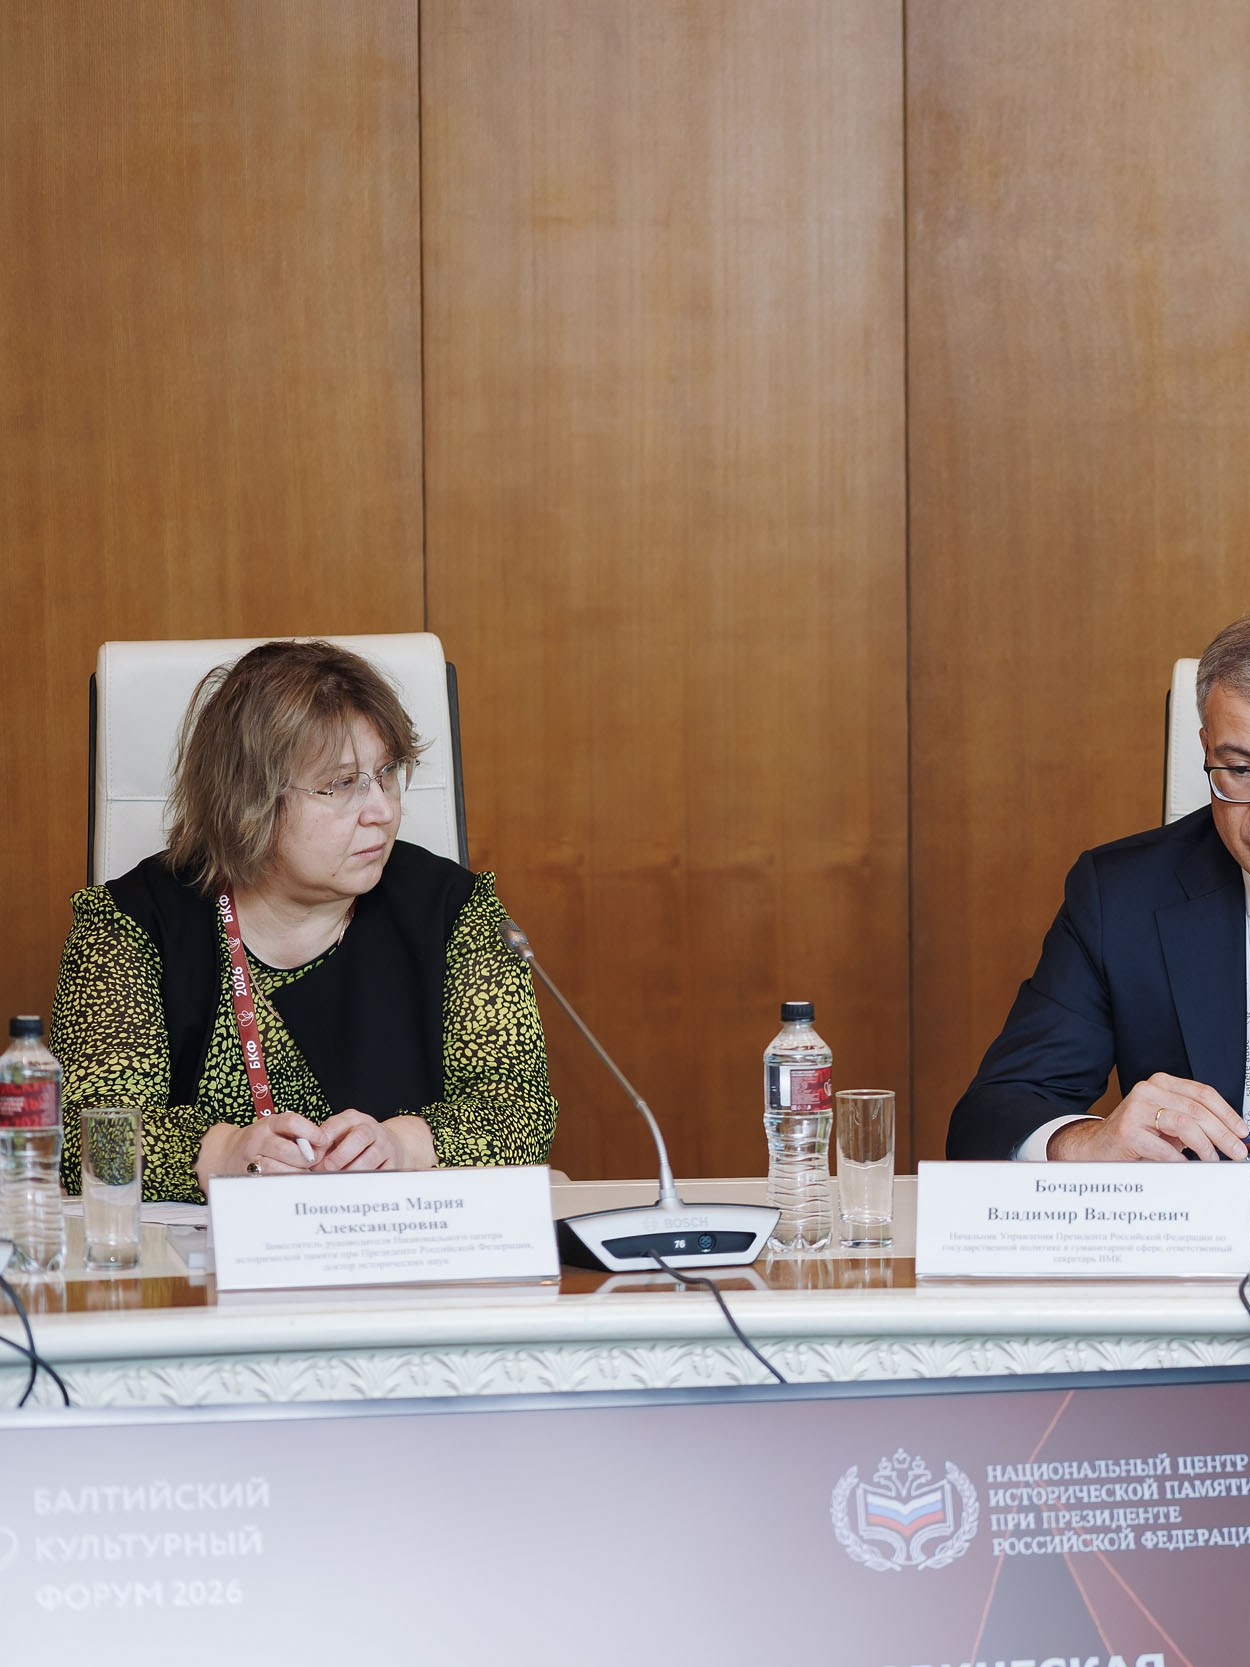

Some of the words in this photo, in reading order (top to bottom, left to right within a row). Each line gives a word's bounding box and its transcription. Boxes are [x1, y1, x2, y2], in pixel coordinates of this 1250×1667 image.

[218, 895, 234, 923] БКФ
[231, 966, 248, 997] 2026
[246, 1040, 262, 1069] БКФ
[1035, 1179, 1144, 1196] Бочарников
[294, 1200, 400, 1216] Пономарева
[406, 1197, 464, 1213] Мария
[987, 1207, 1079, 1224] Владимир
[1084, 1207, 1190, 1224] Валерьевич
[315, 1219, 448, 1236] Александровна
[663, 1216, 709, 1229] BOSCH
[986, 1454, 1171, 1485] НАЦИОНАЛЬНЫЙ
[1177, 1453, 1250, 1477] ЦЕНТР
[33, 1476, 271, 1516] БАЛТИЙСКИЙ
[988, 1480, 1160, 1508] ИСТОРИЧЕСКОЙ
[990, 1508, 1036, 1532] ПРИ
[1042, 1505, 1183, 1530] ПРЕЗИДЕНТЕ
[34, 1523, 263, 1563] КУЛЬТУРНЫЙ
[993, 1528, 1136, 1557] РОССИЙСКОЙ
[34, 1581, 163, 1613] ФОРУМ
[171, 1579, 244, 1607] 2026
